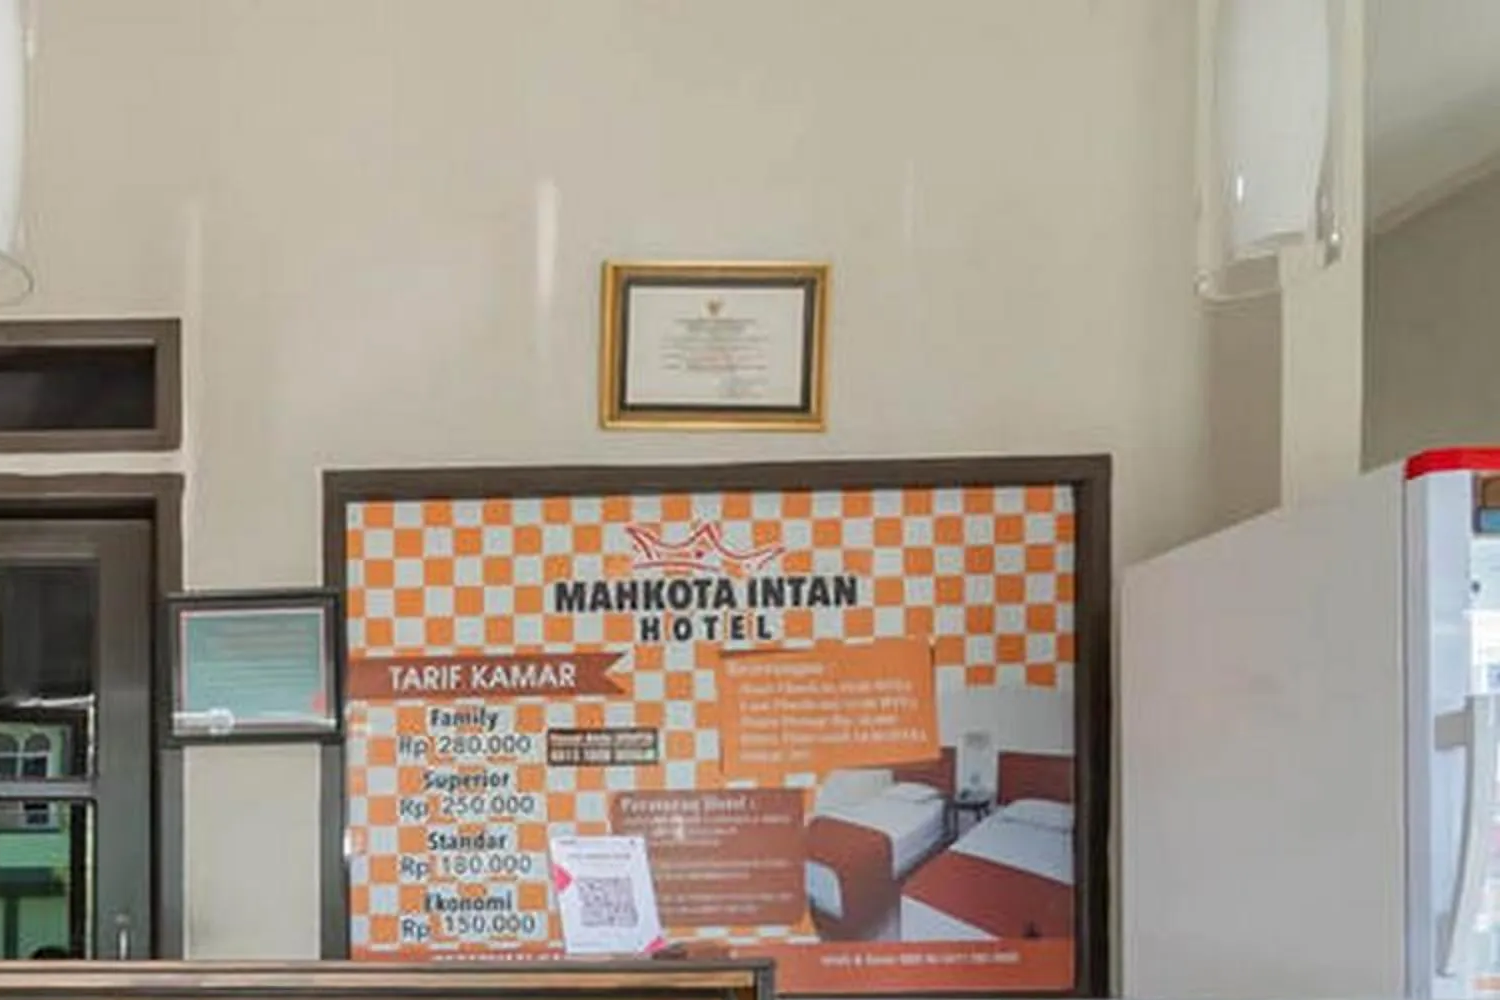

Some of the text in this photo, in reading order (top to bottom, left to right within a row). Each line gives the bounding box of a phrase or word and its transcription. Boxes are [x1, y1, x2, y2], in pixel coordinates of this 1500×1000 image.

[554, 575, 858, 612] MAHKOTA INTAN
[640, 614, 773, 641] HOTEL
[389, 662, 576, 691] TARIF KAMAR
[430, 707, 499, 731] Family
[423, 769, 510, 791] Superior
[399, 796, 535, 819] Rp 250.000
[428, 831, 509, 851] Standar
[401, 854, 533, 878] Rp 180.000
[402, 914, 535, 940] Rp 150.000
